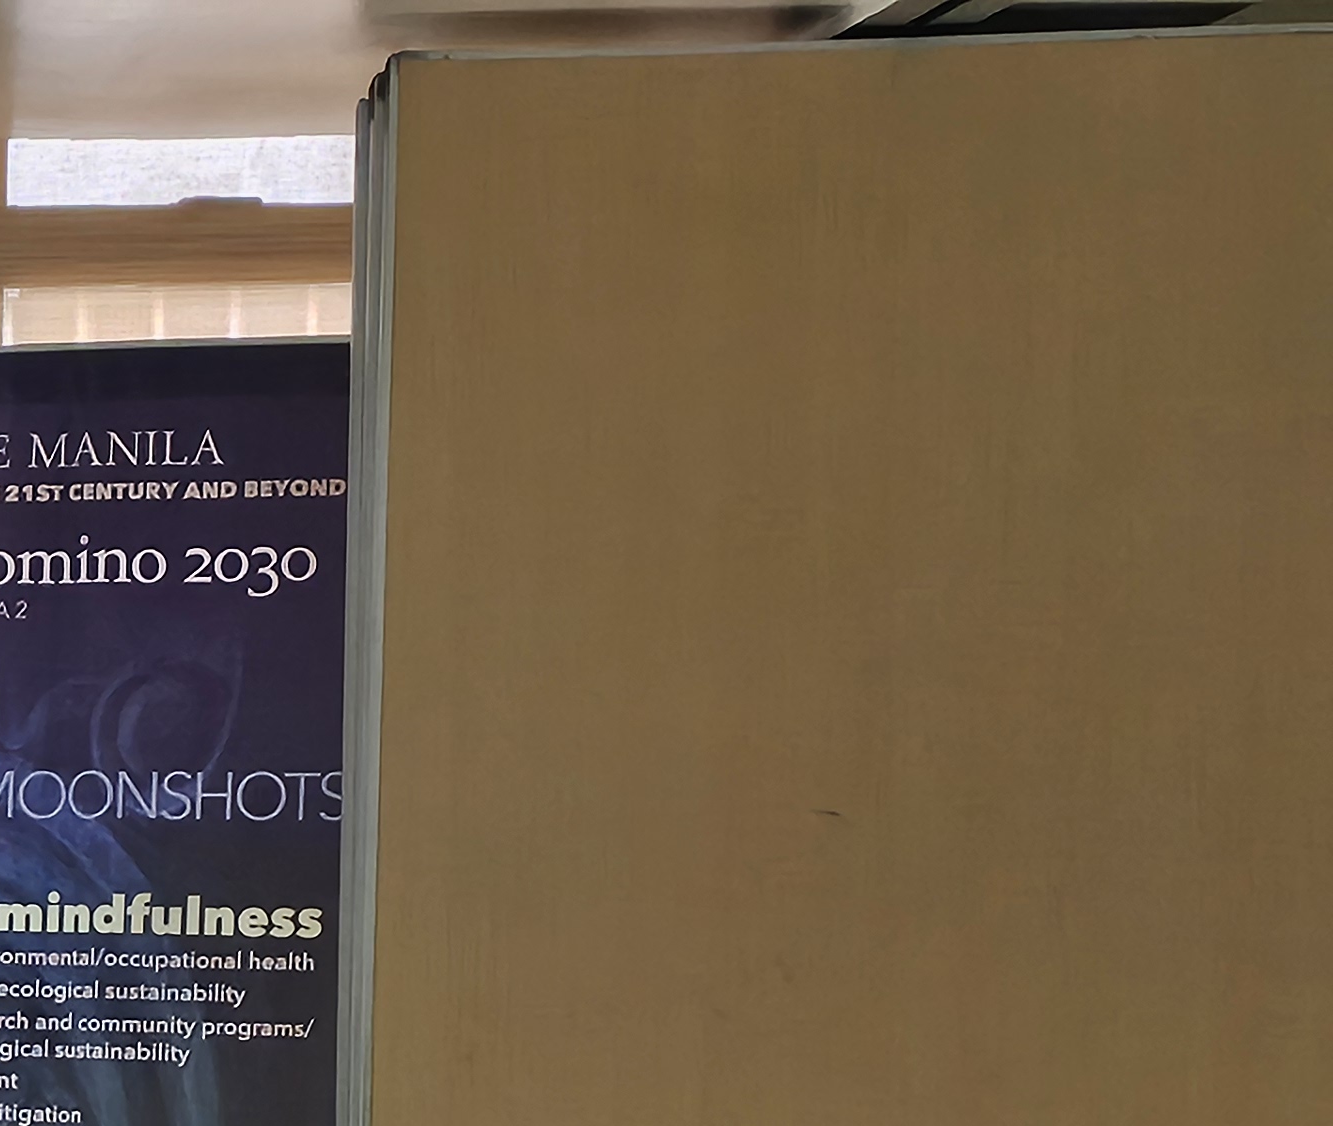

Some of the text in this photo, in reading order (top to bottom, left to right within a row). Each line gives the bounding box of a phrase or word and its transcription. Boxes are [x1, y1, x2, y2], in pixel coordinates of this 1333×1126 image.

[28, 429, 224, 470] MANILA
[5, 484, 64, 503] 21ST
[70, 481, 177, 501] CENTURY
[183, 480, 238, 499] AND
[244, 477, 346, 498] BEYOND
[184, 544, 317, 597] 2030
[15, 600, 28, 619] 2
[248, 949, 315, 972] health
[105, 981, 246, 1007] sustainability
[35, 1012, 72, 1032] and
[77, 1014, 196, 1039] community
[201, 1017, 315, 1042] programs/
[55, 1040, 191, 1067] sustainability
